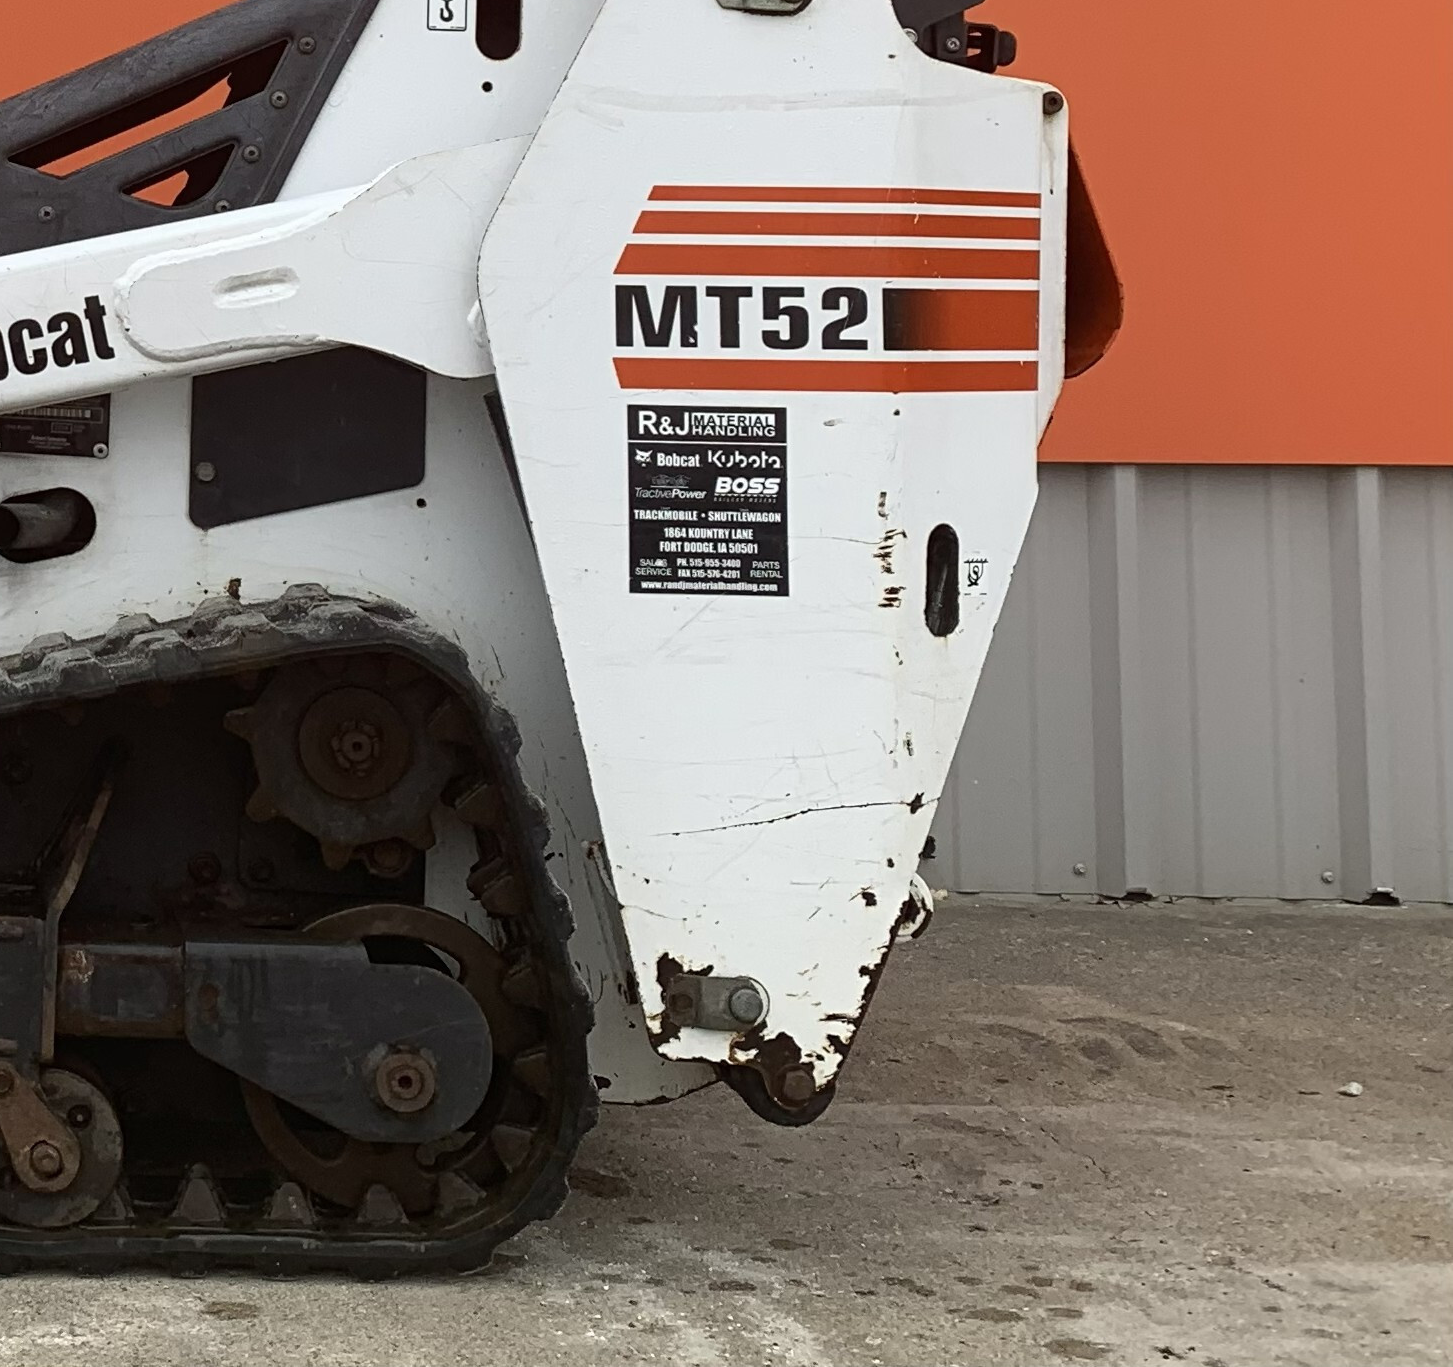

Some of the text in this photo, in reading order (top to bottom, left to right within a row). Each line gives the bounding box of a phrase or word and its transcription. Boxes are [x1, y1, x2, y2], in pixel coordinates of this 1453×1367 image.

[615, 284, 869, 350] MT52
[638, 410, 690, 435] R&J
[693, 414, 774, 427] MATERIAL
[692, 426, 776, 437] HANDLING
[657, 453, 701, 467] Bobcat
[708, 450, 782, 468] Kubota
[715, 477, 782, 494] BOSS
[635, 487, 708, 500] TractivePower
[633, 510, 782, 523] TRACKMOBILE SHUTTLEWAGON
[664, 527, 754, 540] 1864 KOUNTRY LANE
[659, 541, 683, 552] FORT
[718, 543, 727, 553] IA
[729, 543, 758, 554] 50501
[635, 567, 672, 576] SERVICE
[752, 561, 780, 569] PARTS
[678, 569, 691, 578] FAX
[750, 570, 783, 578] RENTAL
